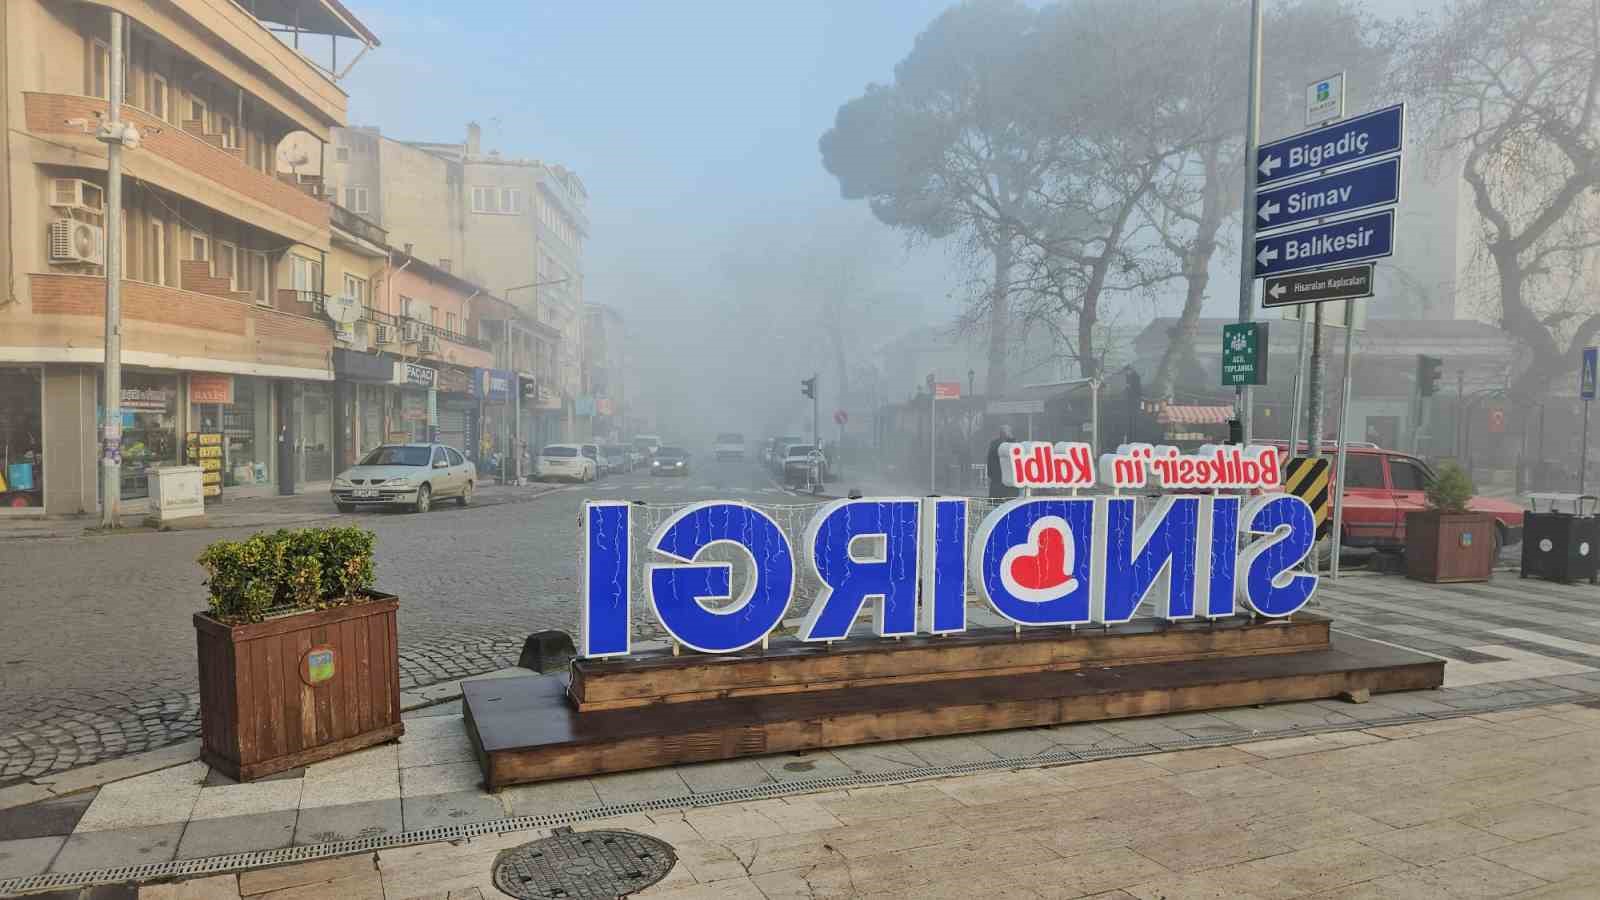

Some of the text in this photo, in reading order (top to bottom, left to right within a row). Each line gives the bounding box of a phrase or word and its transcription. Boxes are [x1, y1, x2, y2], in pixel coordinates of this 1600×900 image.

[1289, 131, 1369, 168] Bigadiç
[1287, 185, 1352, 214] Simav
[1285, 227, 1374, 261] Balıkesir
[1294, 280, 1326, 294] Hisaralan
